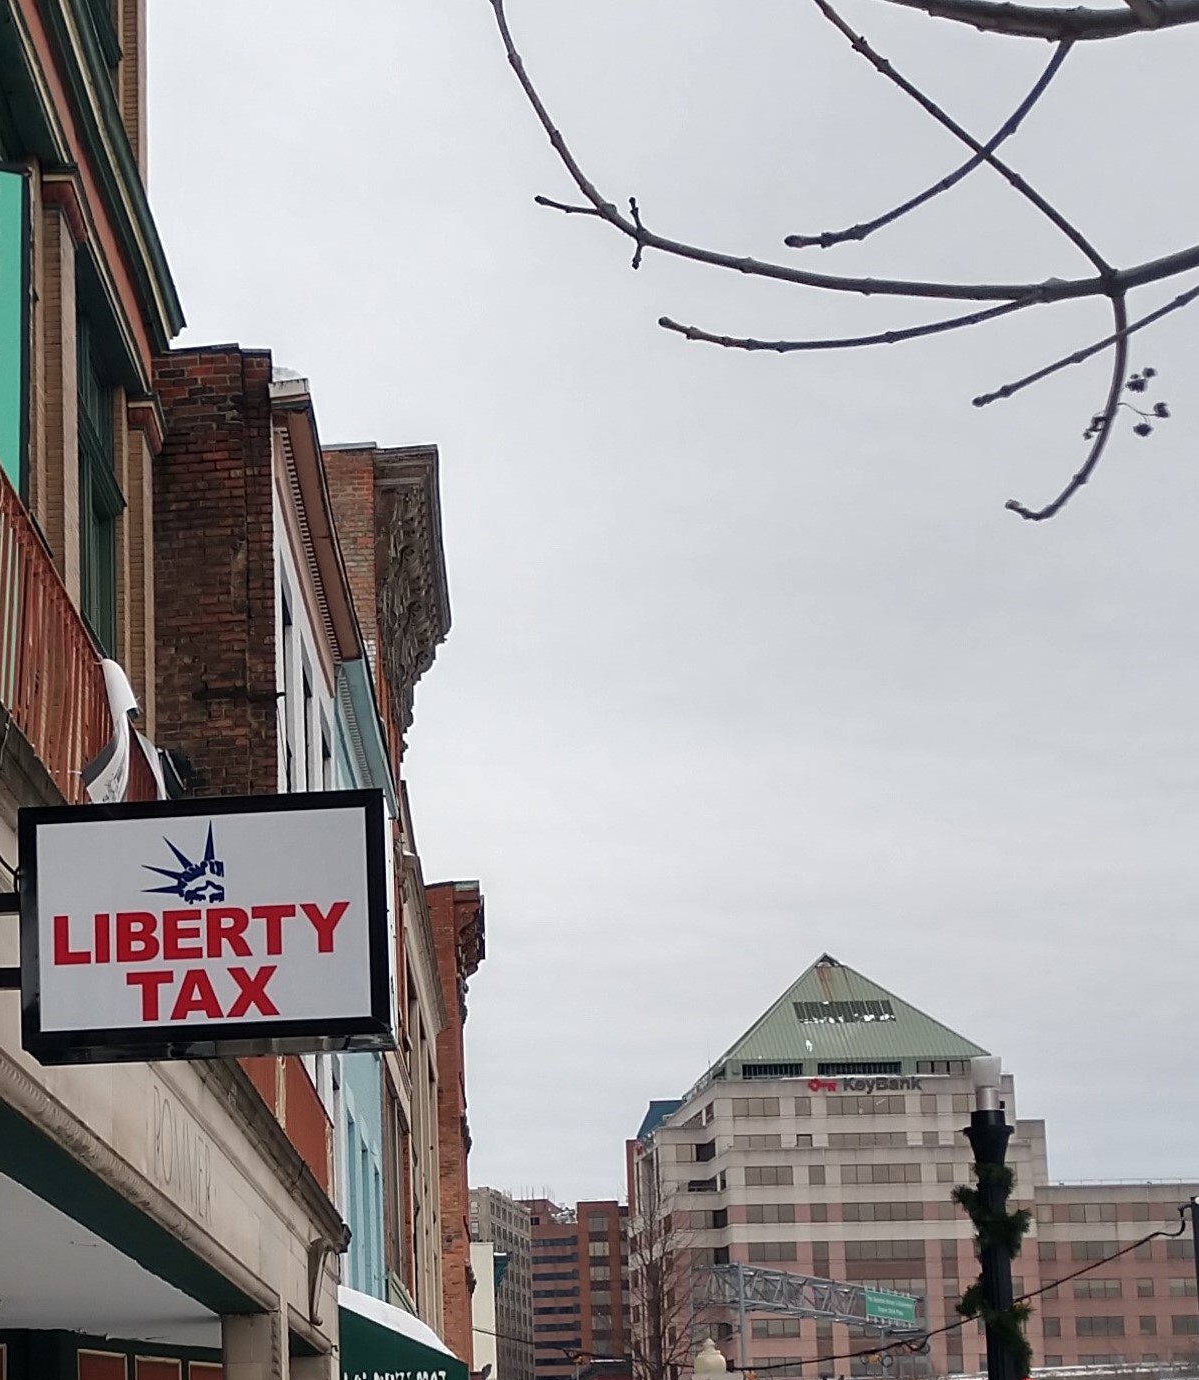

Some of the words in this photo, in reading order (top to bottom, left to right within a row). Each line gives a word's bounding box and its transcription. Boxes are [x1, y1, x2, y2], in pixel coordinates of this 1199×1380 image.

[53, 902, 350, 966] LIBERTY
[126, 966, 280, 1022] TAX
[843, 1077, 922, 1094] KeyBank
